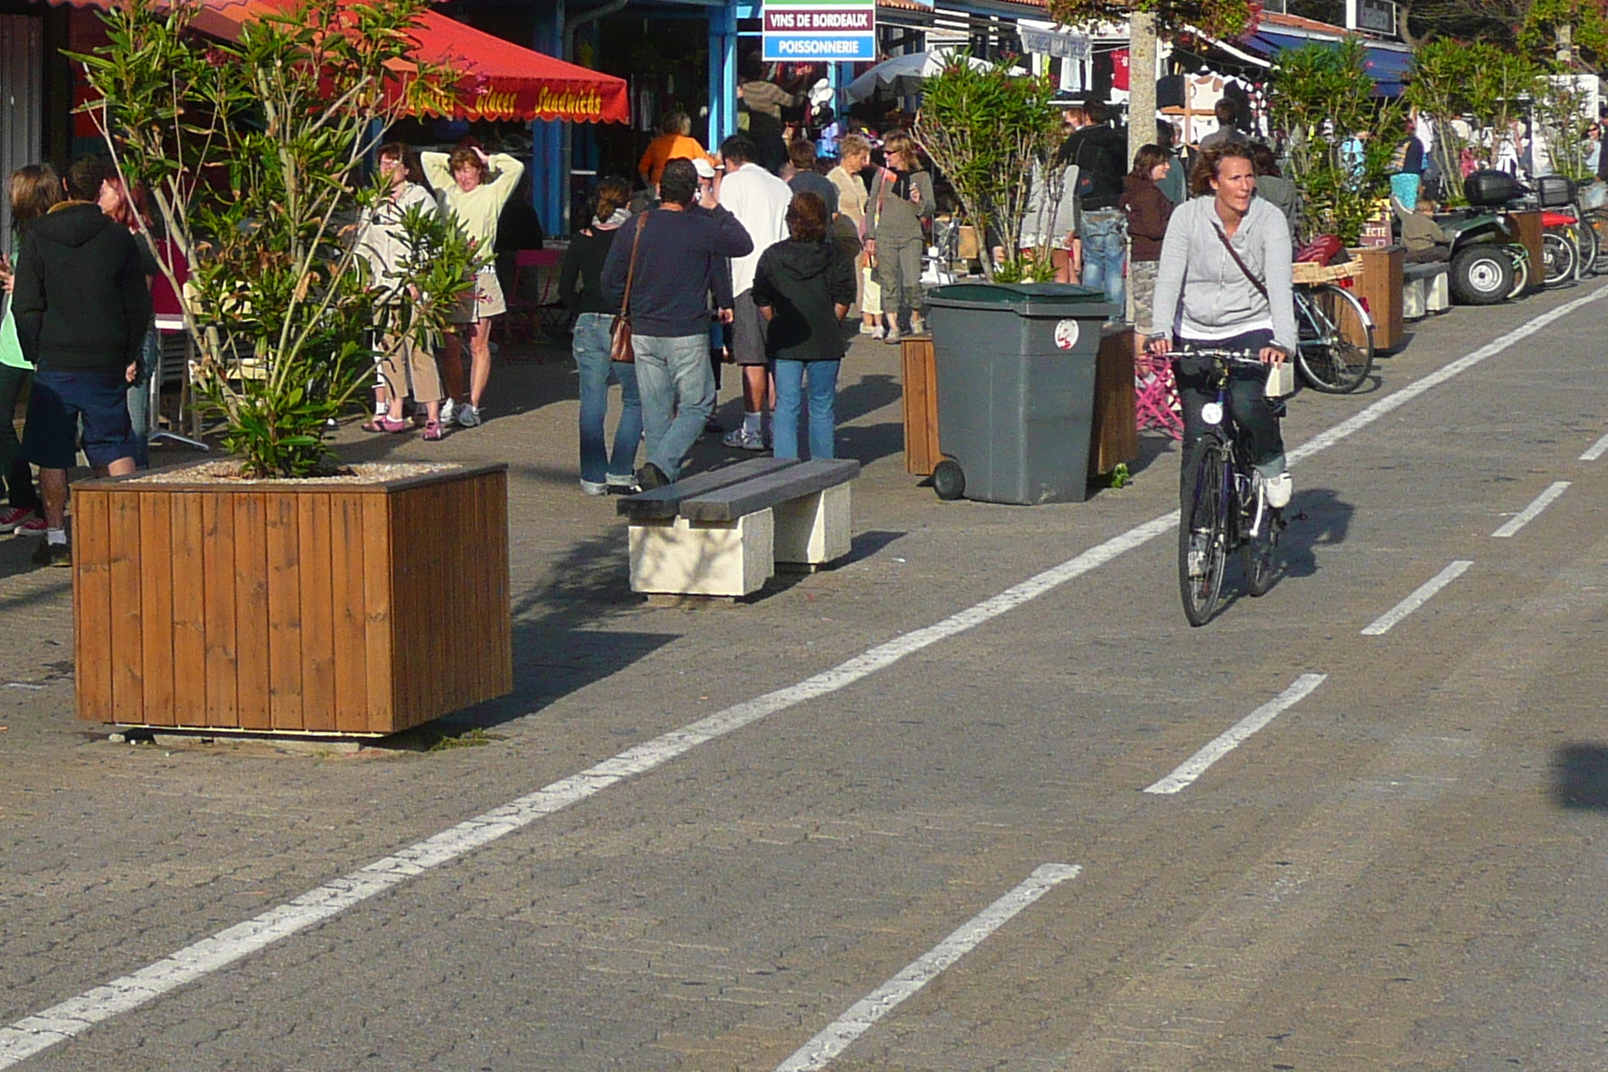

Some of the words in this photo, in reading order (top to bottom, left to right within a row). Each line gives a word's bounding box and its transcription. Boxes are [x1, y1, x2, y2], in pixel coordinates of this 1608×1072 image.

[770, 14, 795, 28] VINS
[797, 14, 810, 27] DE
[812, 13, 868, 28] BORDEAUX
[778, 40, 860, 54] POISSONNERIE
[534, 86, 602, 115] Sandwichs
